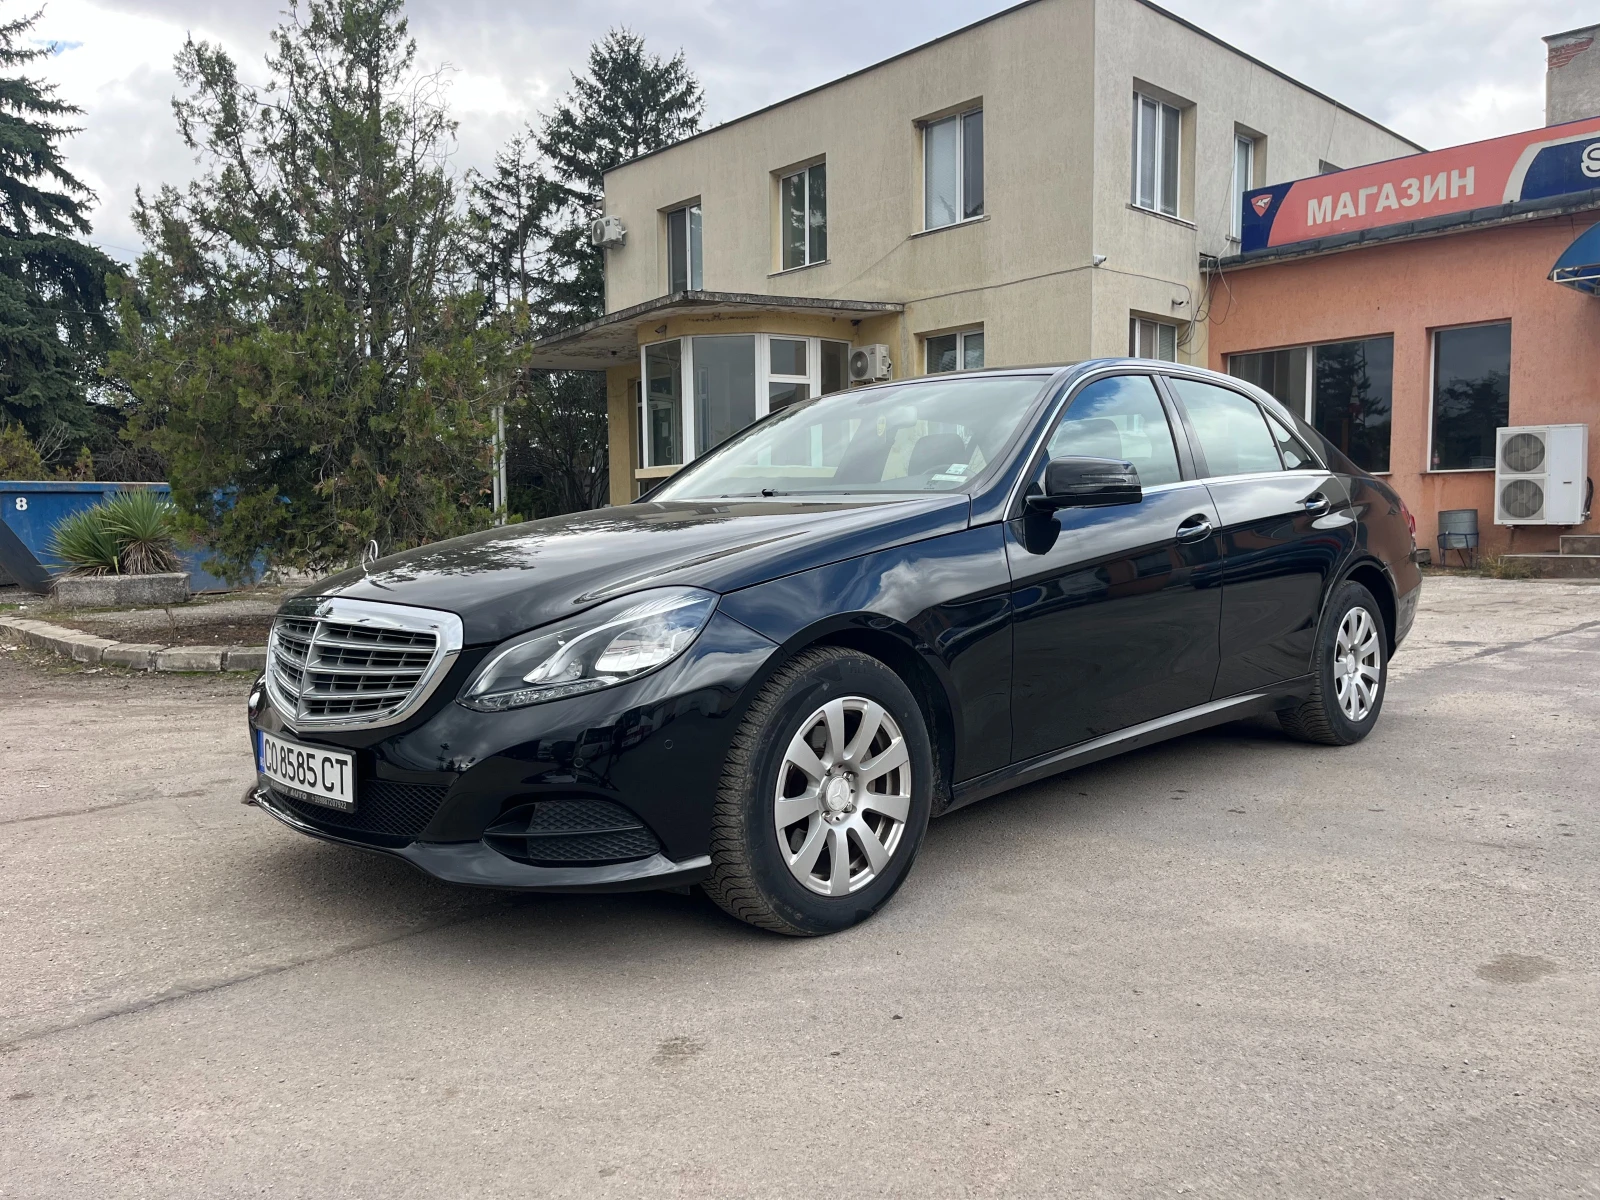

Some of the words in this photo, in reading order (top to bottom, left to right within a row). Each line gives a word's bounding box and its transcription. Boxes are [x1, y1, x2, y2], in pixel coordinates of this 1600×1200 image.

[1307, 166, 1475, 227] МАГАЗИН
[15, 497, 28, 511] 8
[264, 738, 278, 775] CO
[279, 745, 317, 788] 8585
[321, 756, 349, 796] CT
[290, 789, 308, 800] AUTO
